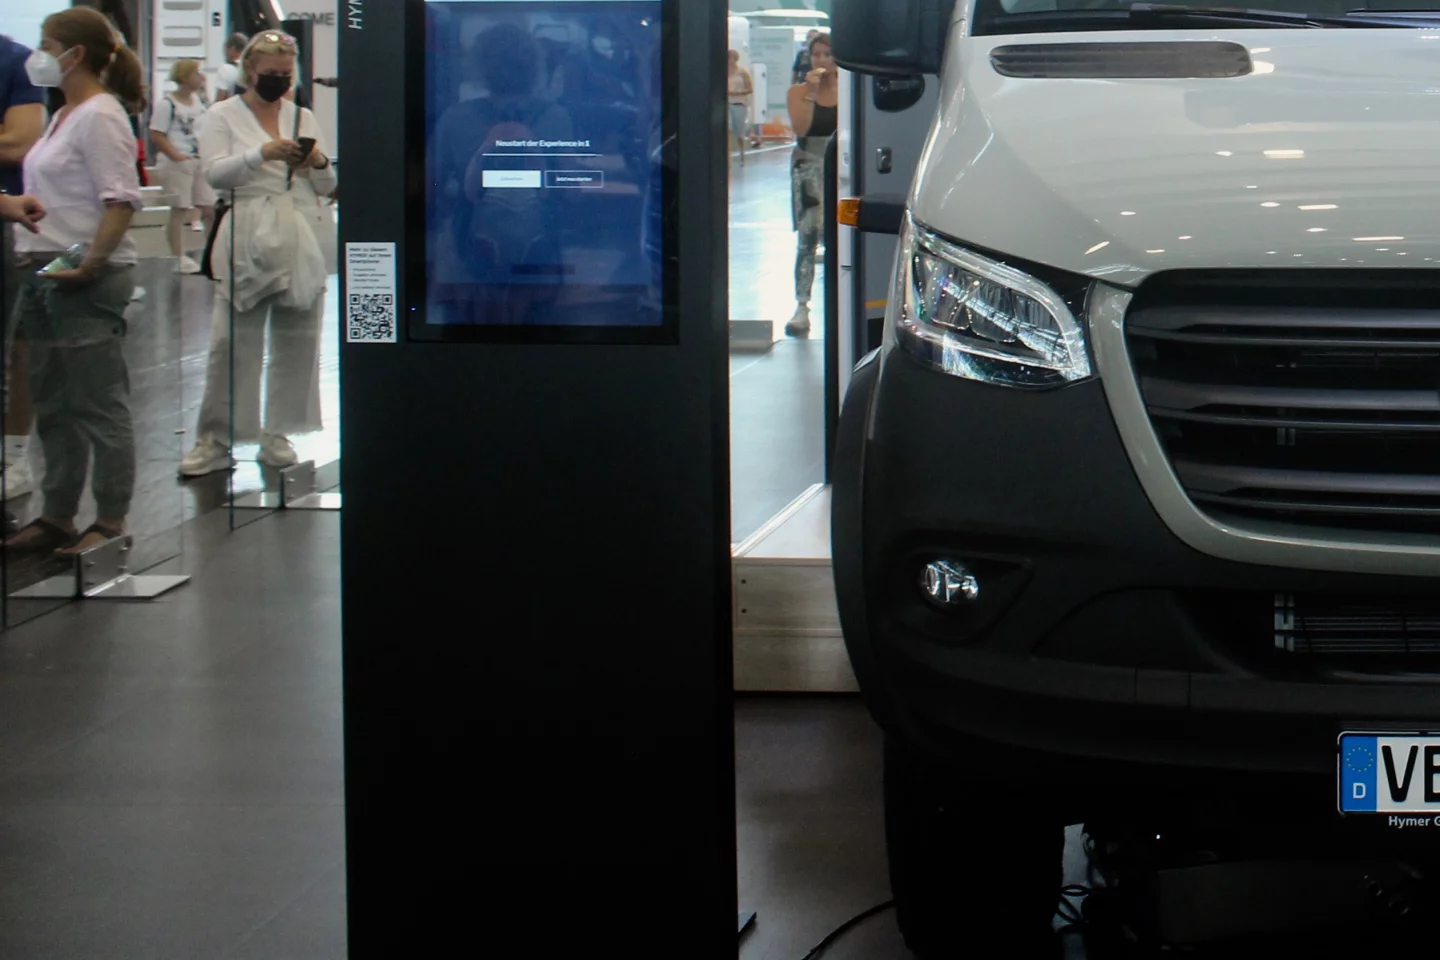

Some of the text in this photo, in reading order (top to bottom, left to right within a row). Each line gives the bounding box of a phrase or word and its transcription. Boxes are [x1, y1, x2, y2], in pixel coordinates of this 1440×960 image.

[539, 140, 577, 148] Experience
[1352, 783, 1366, 799] D
[1388, 815, 1430, 828] Hymer
